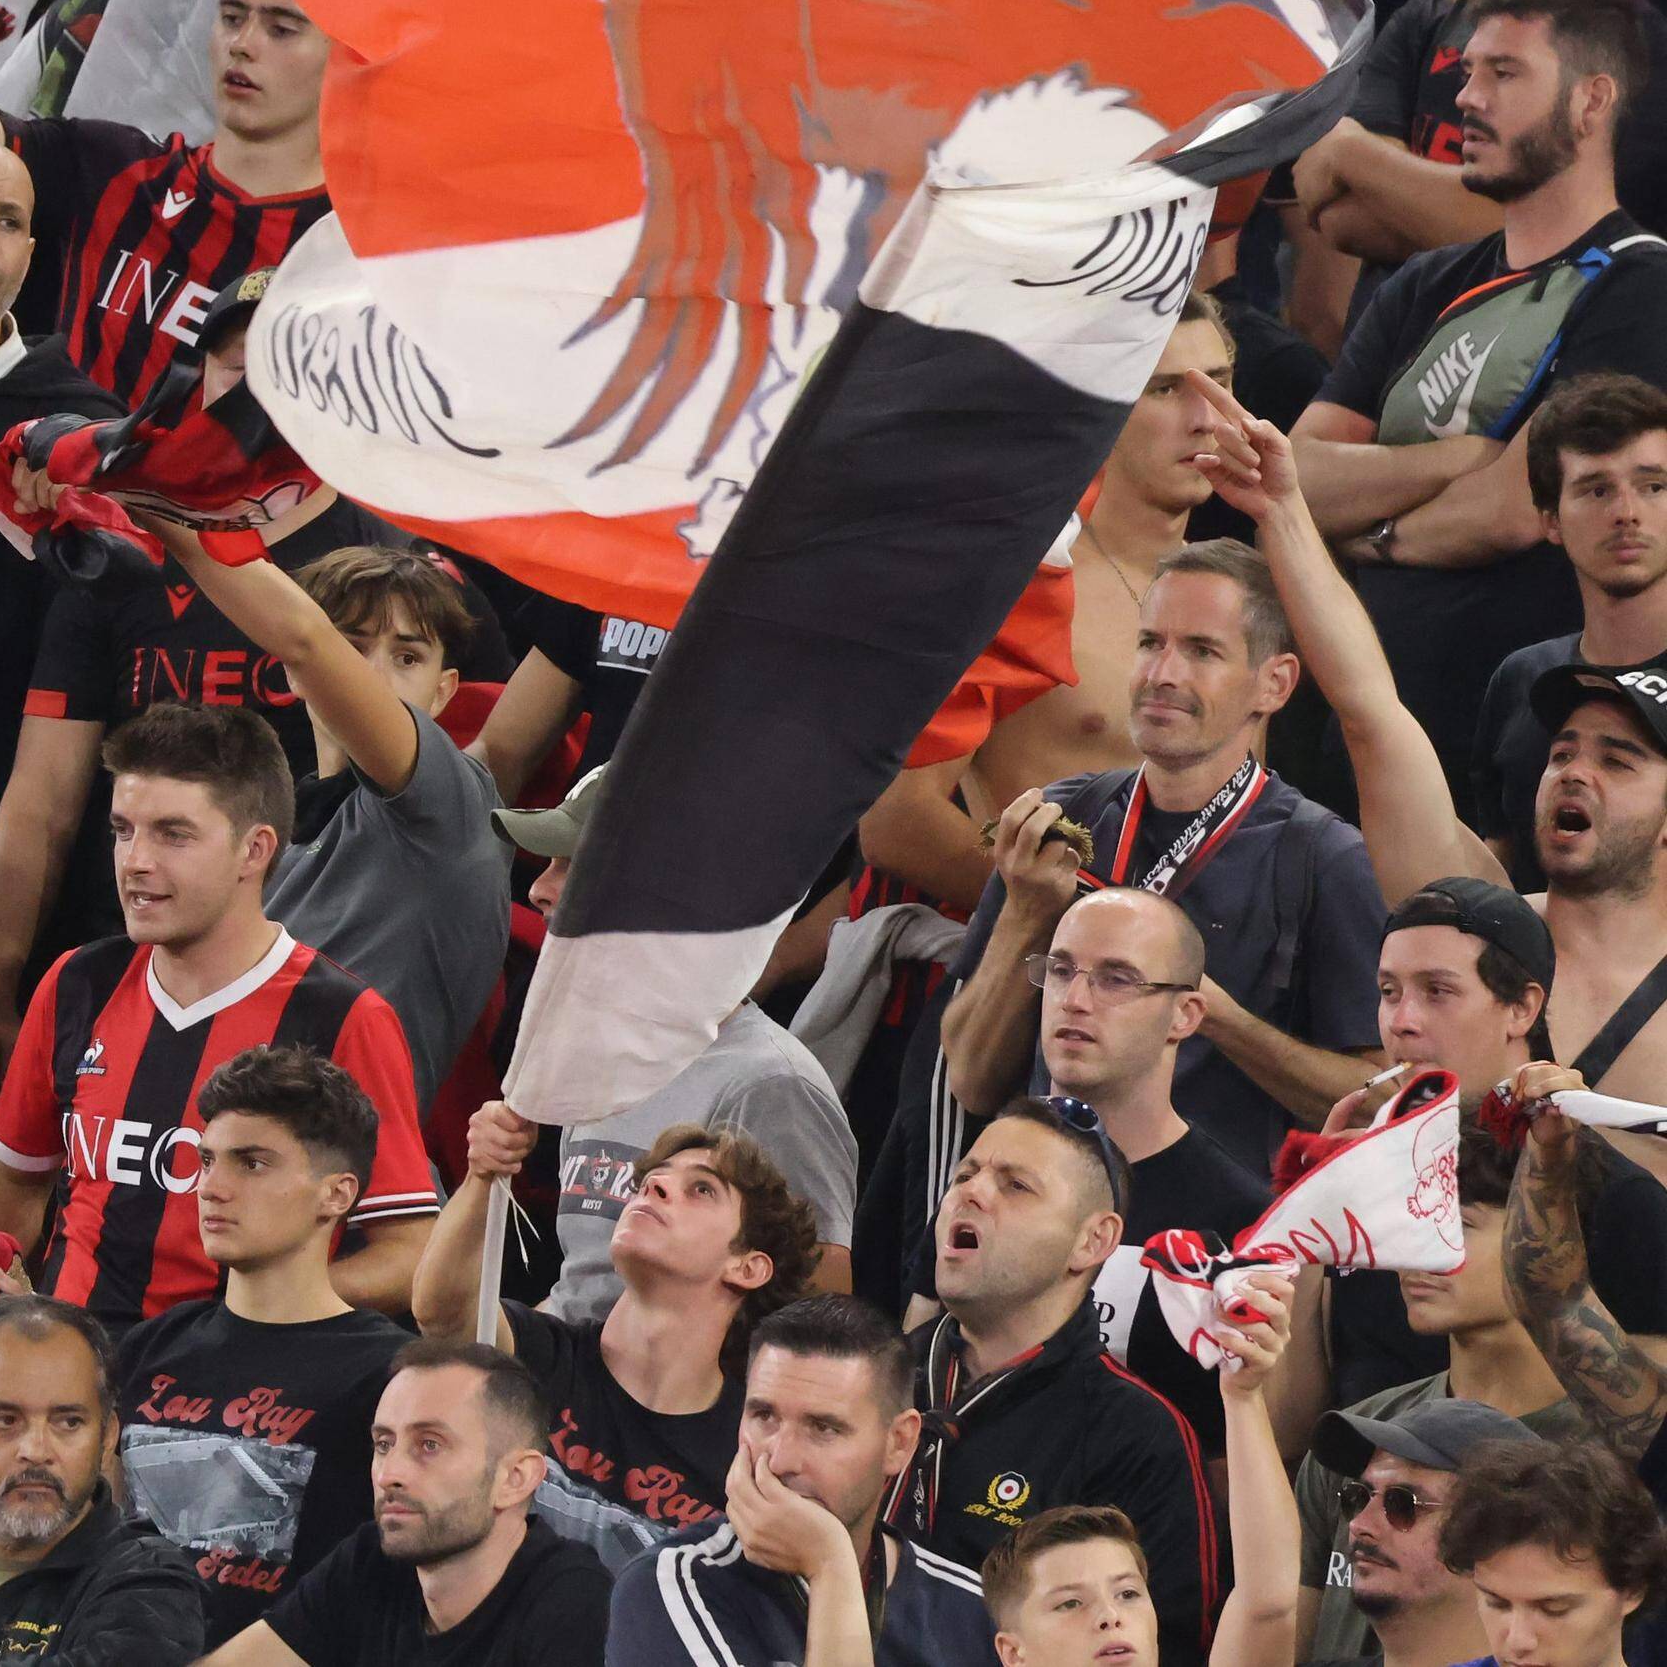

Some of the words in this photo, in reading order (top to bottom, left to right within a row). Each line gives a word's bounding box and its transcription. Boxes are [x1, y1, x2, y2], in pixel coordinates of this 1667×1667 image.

[1418, 331, 1481, 417] NIKE
[61, 1111, 202, 1195] INEO
[134, 1373, 210, 1425] Lou
[222, 1386, 316, 1446] Ray
[549, 1407, 615, 1483] Lou
